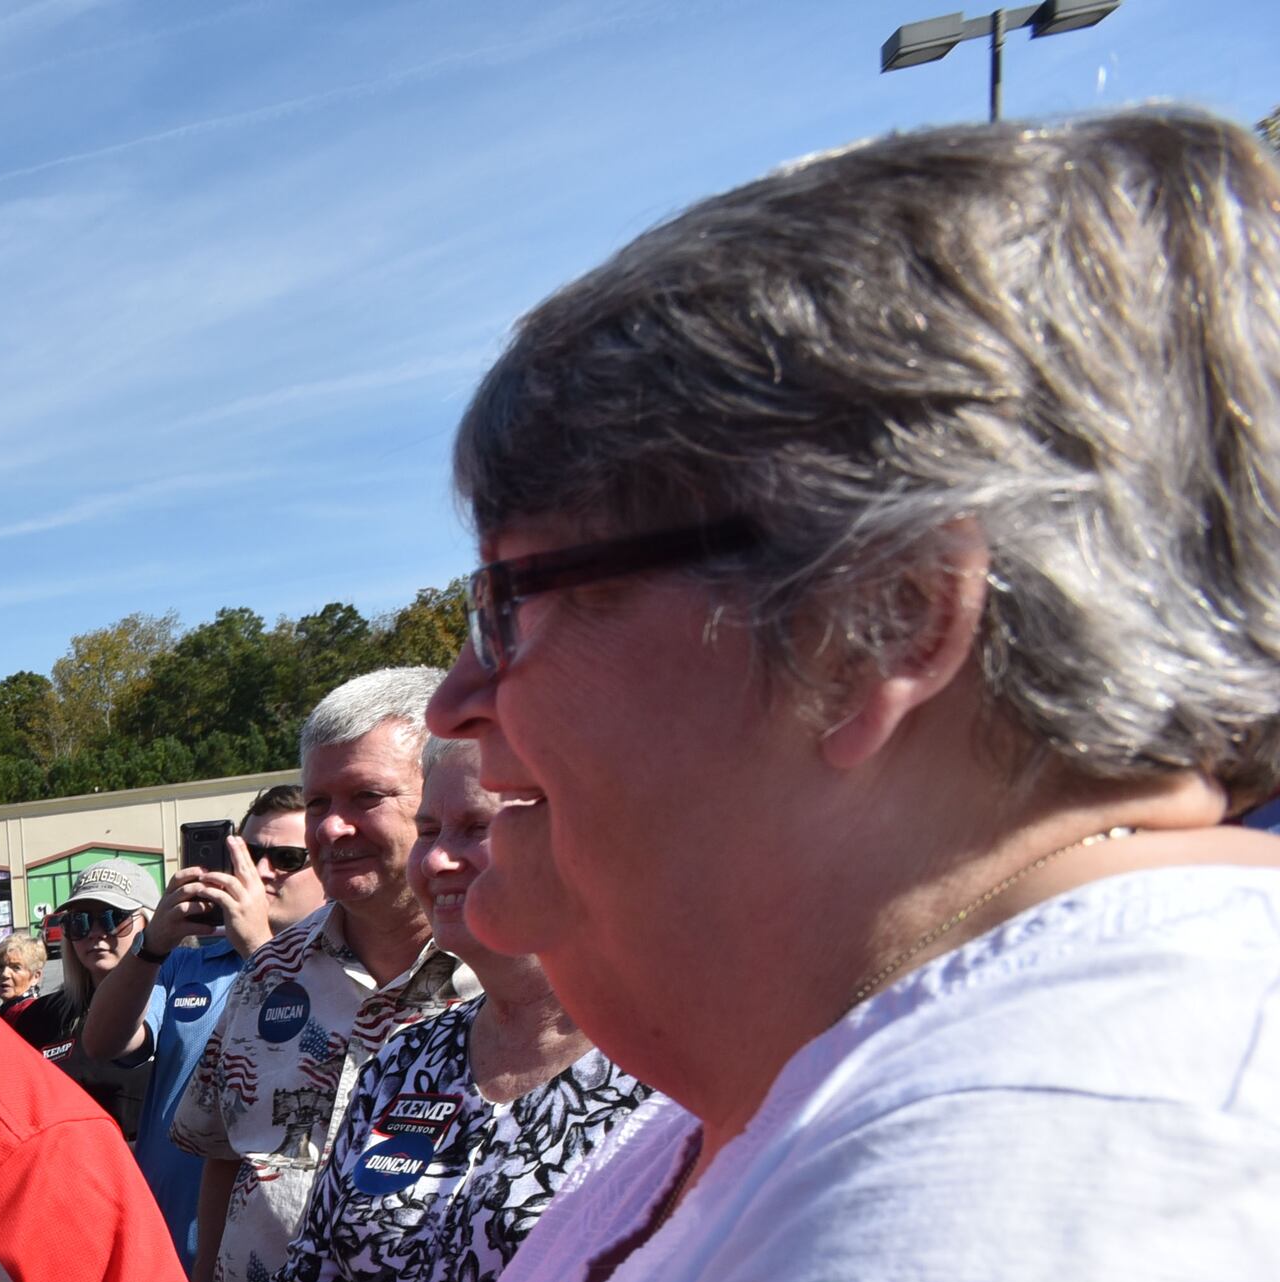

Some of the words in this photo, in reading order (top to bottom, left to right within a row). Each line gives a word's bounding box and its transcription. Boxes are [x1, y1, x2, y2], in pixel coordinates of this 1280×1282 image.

[86, 868, 133, 895] ANGELES
[174, 997, 207, 1007] DUNCAN
[265, 1005, 304, 1021] DUNCAN
[43, 1042, 72, 1058] KEMP
[389, 1100, 457, 1121] KEMP
[387, 1123, 435, 1134] GOVERNOR
[365, 1155, 423, 1174] DUNCAN
